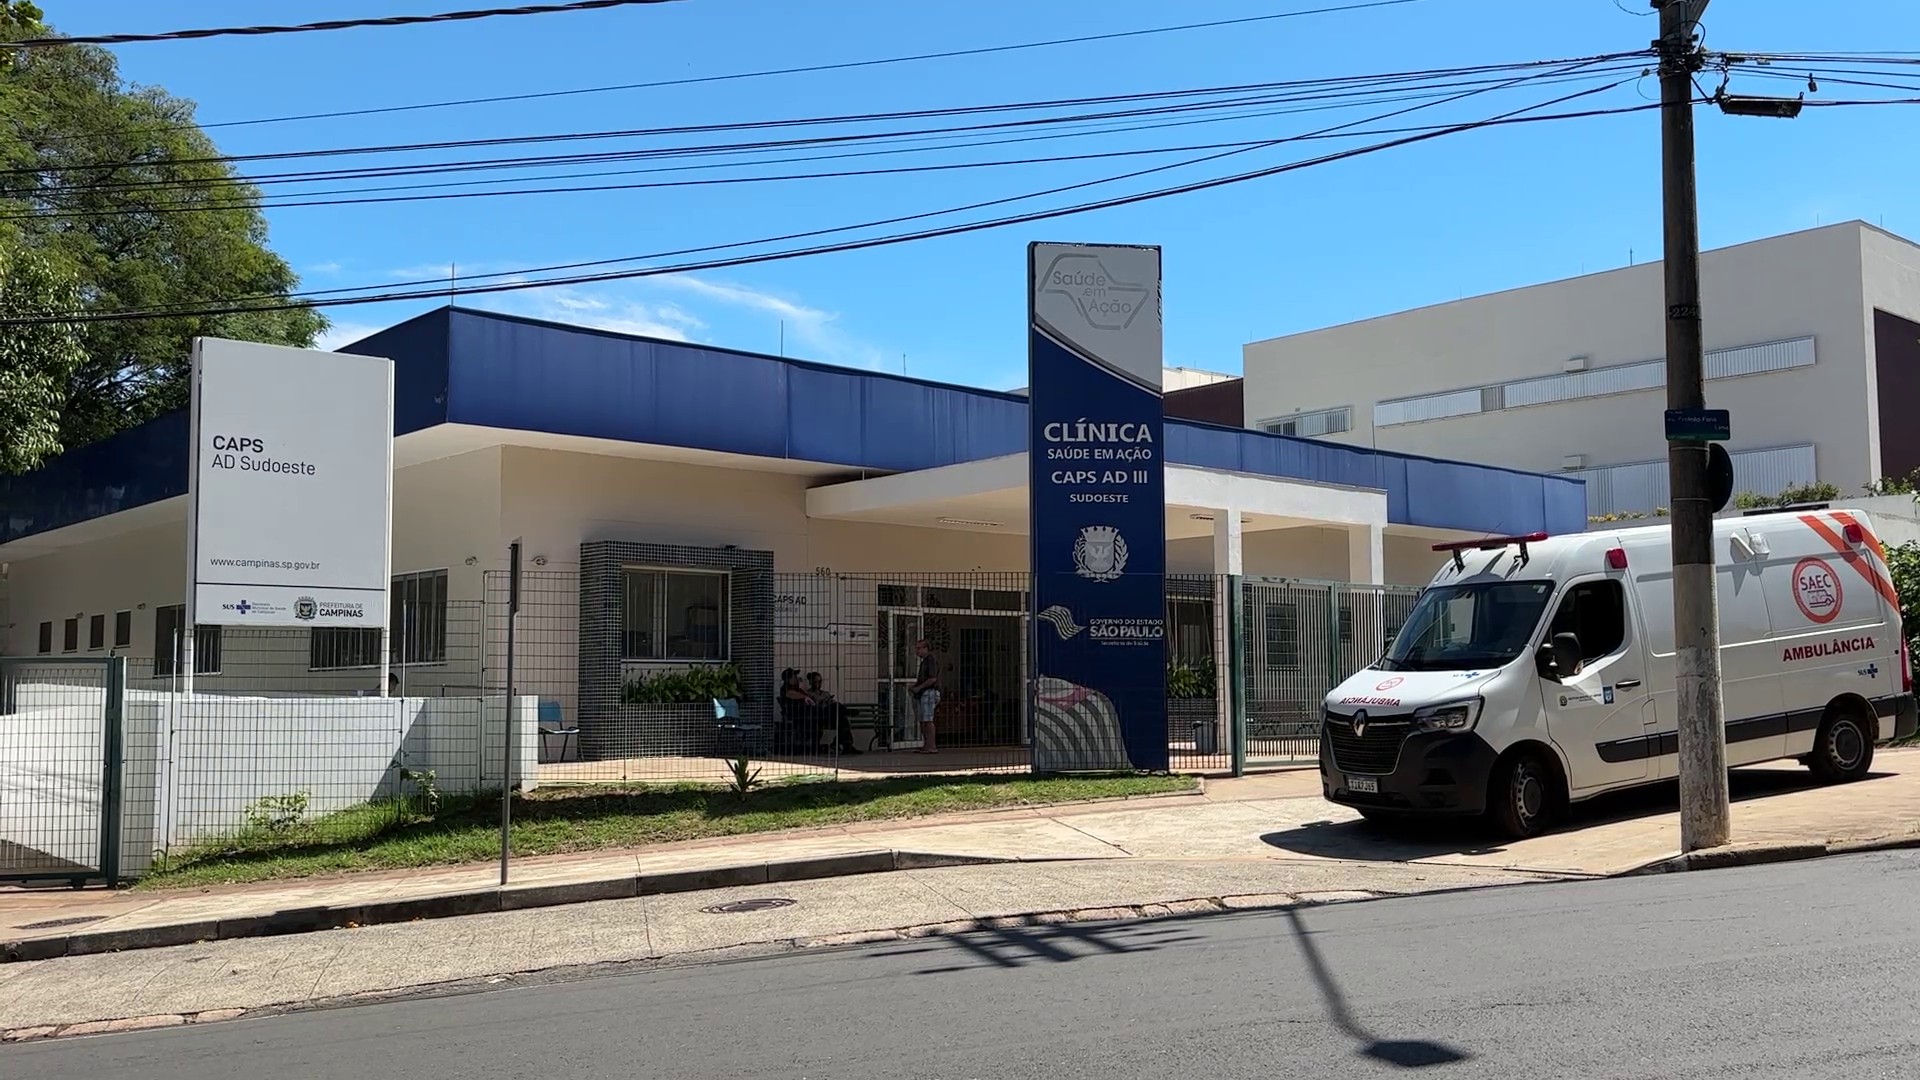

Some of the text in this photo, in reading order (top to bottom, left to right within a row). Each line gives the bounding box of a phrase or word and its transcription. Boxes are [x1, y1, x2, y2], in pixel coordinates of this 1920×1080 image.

[1052, 270, 1106, 286] Saúde
[1084, 287, 1106, 297] em
[1088, 299, 1132, 317] Ação
[1043, 417, 1153, 443] CLÍNICA
[212, 435, 264, 453] CAPS
[1047, 446, 1152, 462] SAÚDE EM AÇÃO
[211, 454, 316, 476] AD Sudoeste
[1051, 470, 1148, 484] CAPS AD III
[1069, 493, 1129, 503] SUDOESTE
[210, 557, 320, 570] www.campinas.sp.gov.br
[815, 567, 831, 576] 560
[1799, 573, 1832, 591] SAEC
[319, 601, 356, 609] PREFEITURA
[319, 608, 364, 618] CAMPINAS
[1089, 624, 1164, 637] SÃO PAULO
[1782, 637, 1875, 662] AMBULÂNCIA
